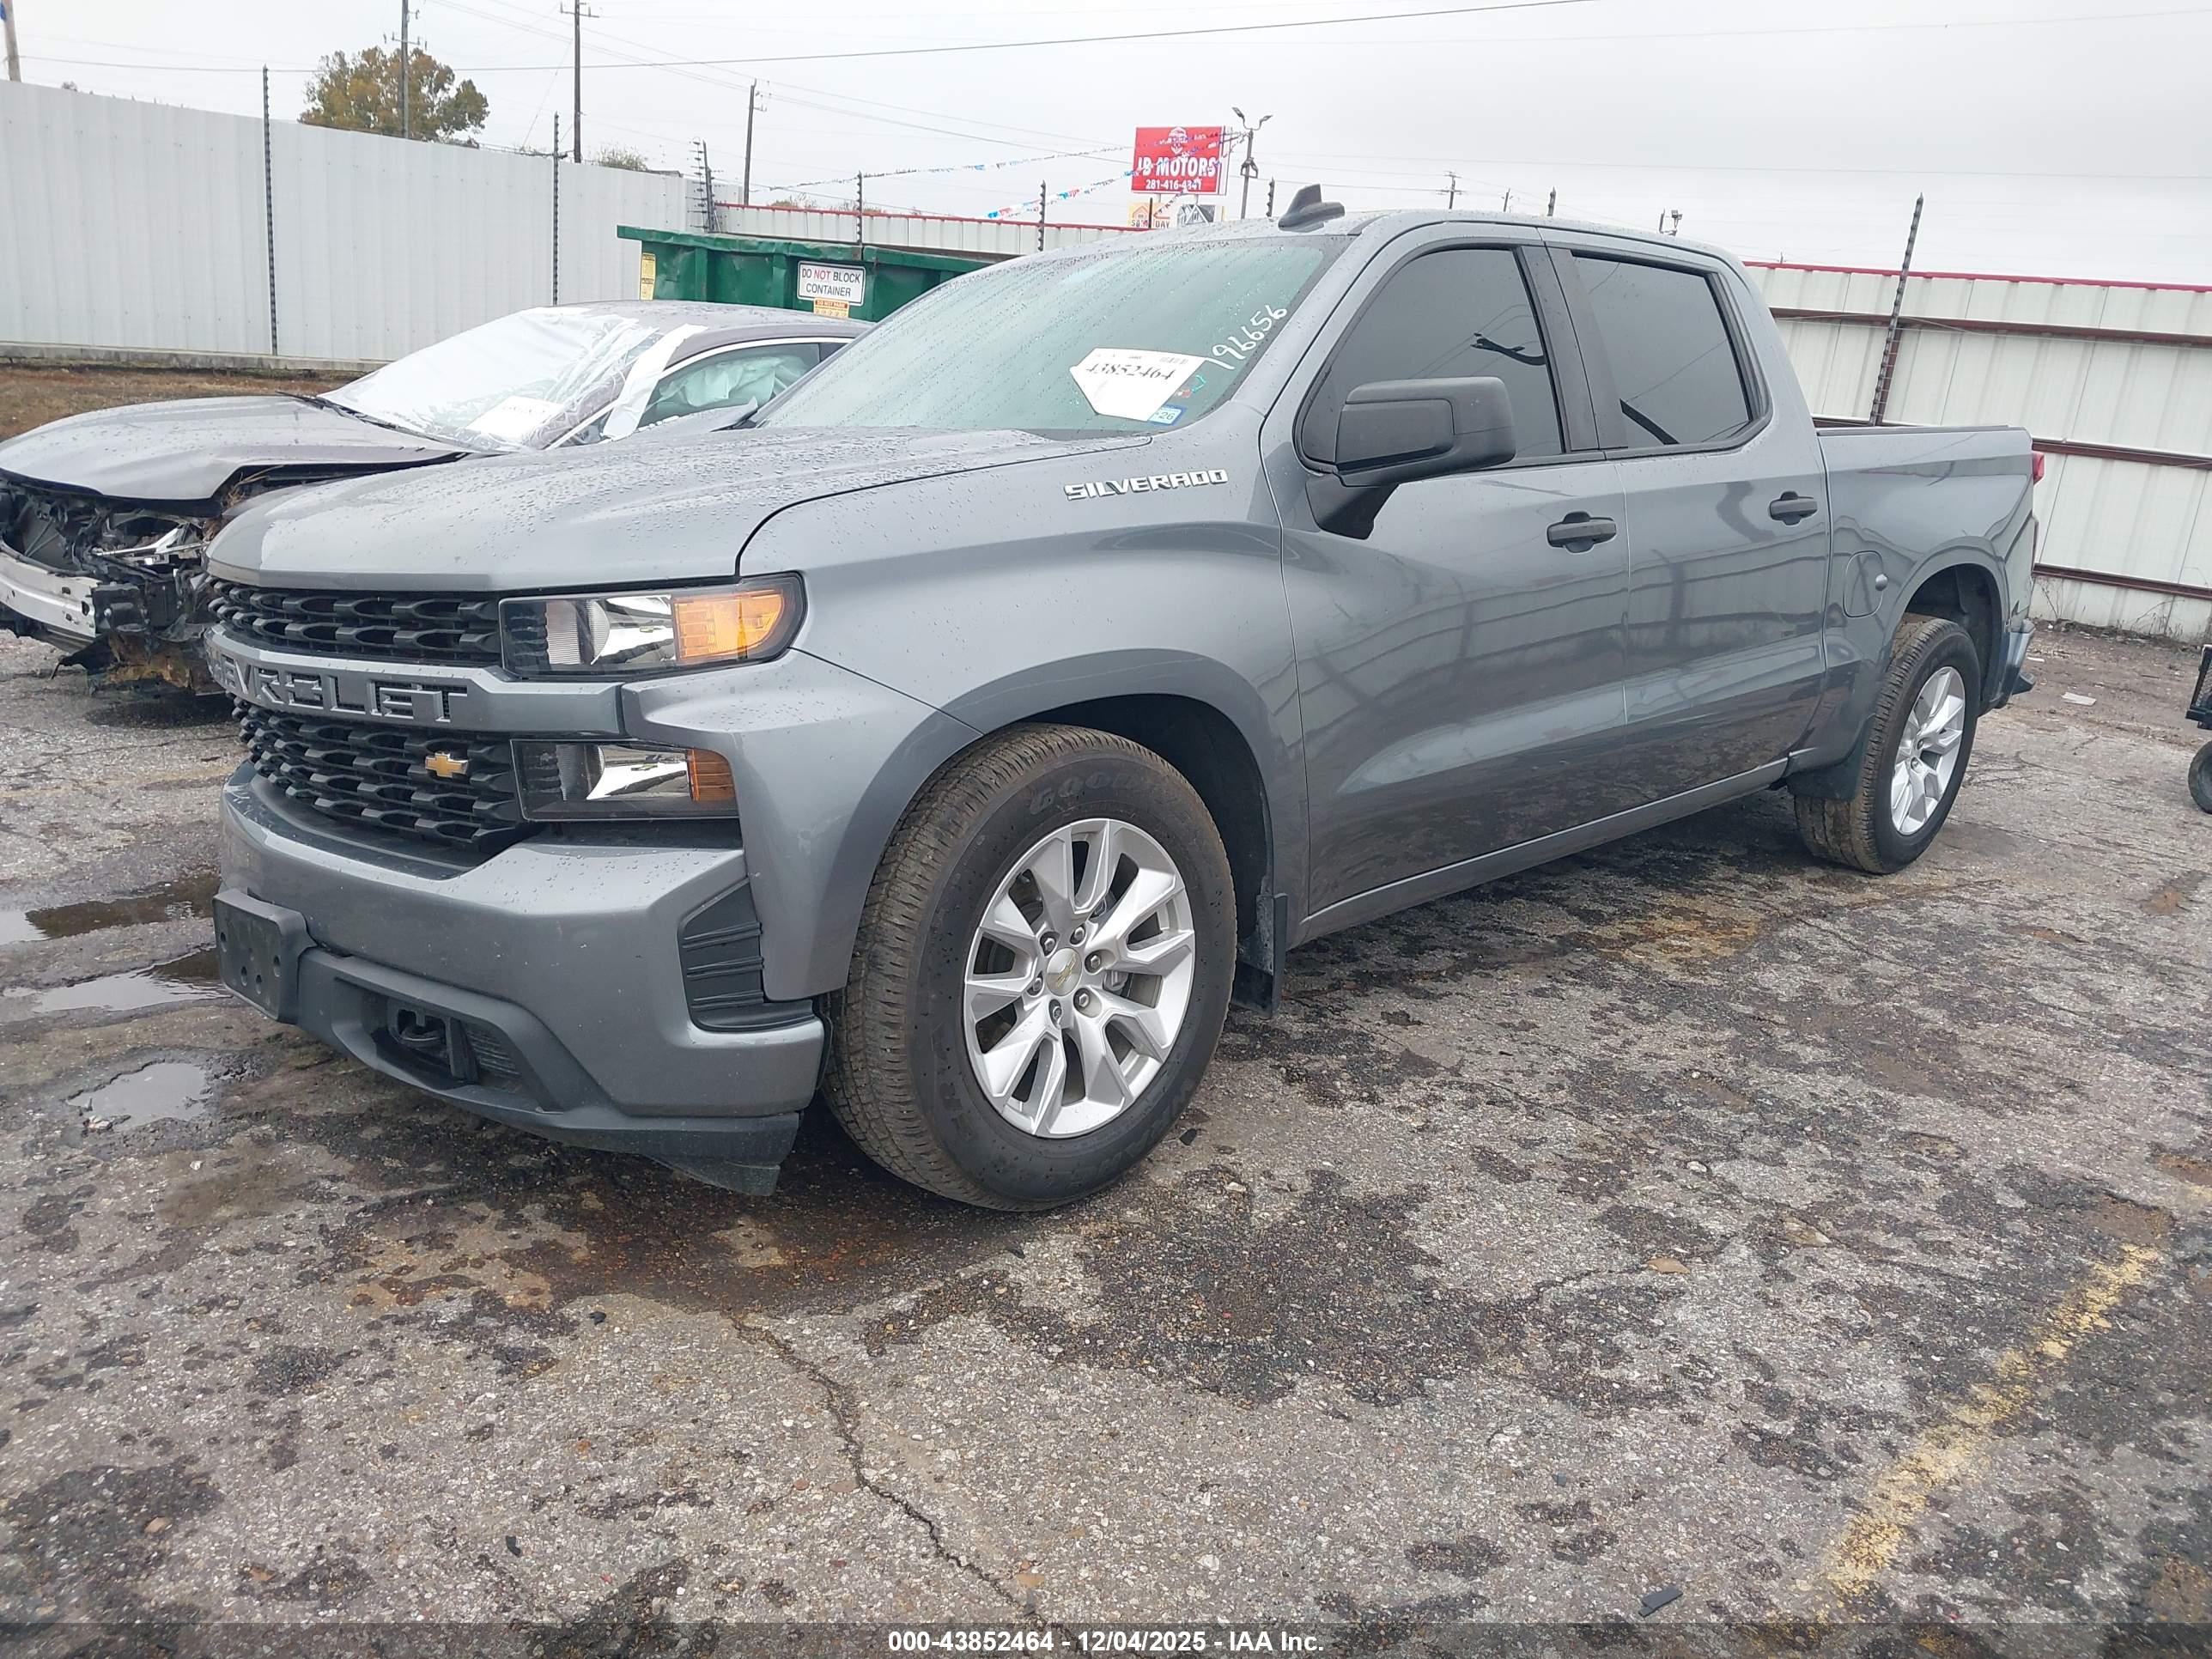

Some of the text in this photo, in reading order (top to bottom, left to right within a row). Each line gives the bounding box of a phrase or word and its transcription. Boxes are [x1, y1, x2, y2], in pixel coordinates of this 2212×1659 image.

[1155, 156, 1217, 177] MOTORS
[801, 268, 861, 284] DO NOT BLOCK
[805, 283, 852, 297] CONTAINER
[1064, 469, 1229, 501] SILVERADO
